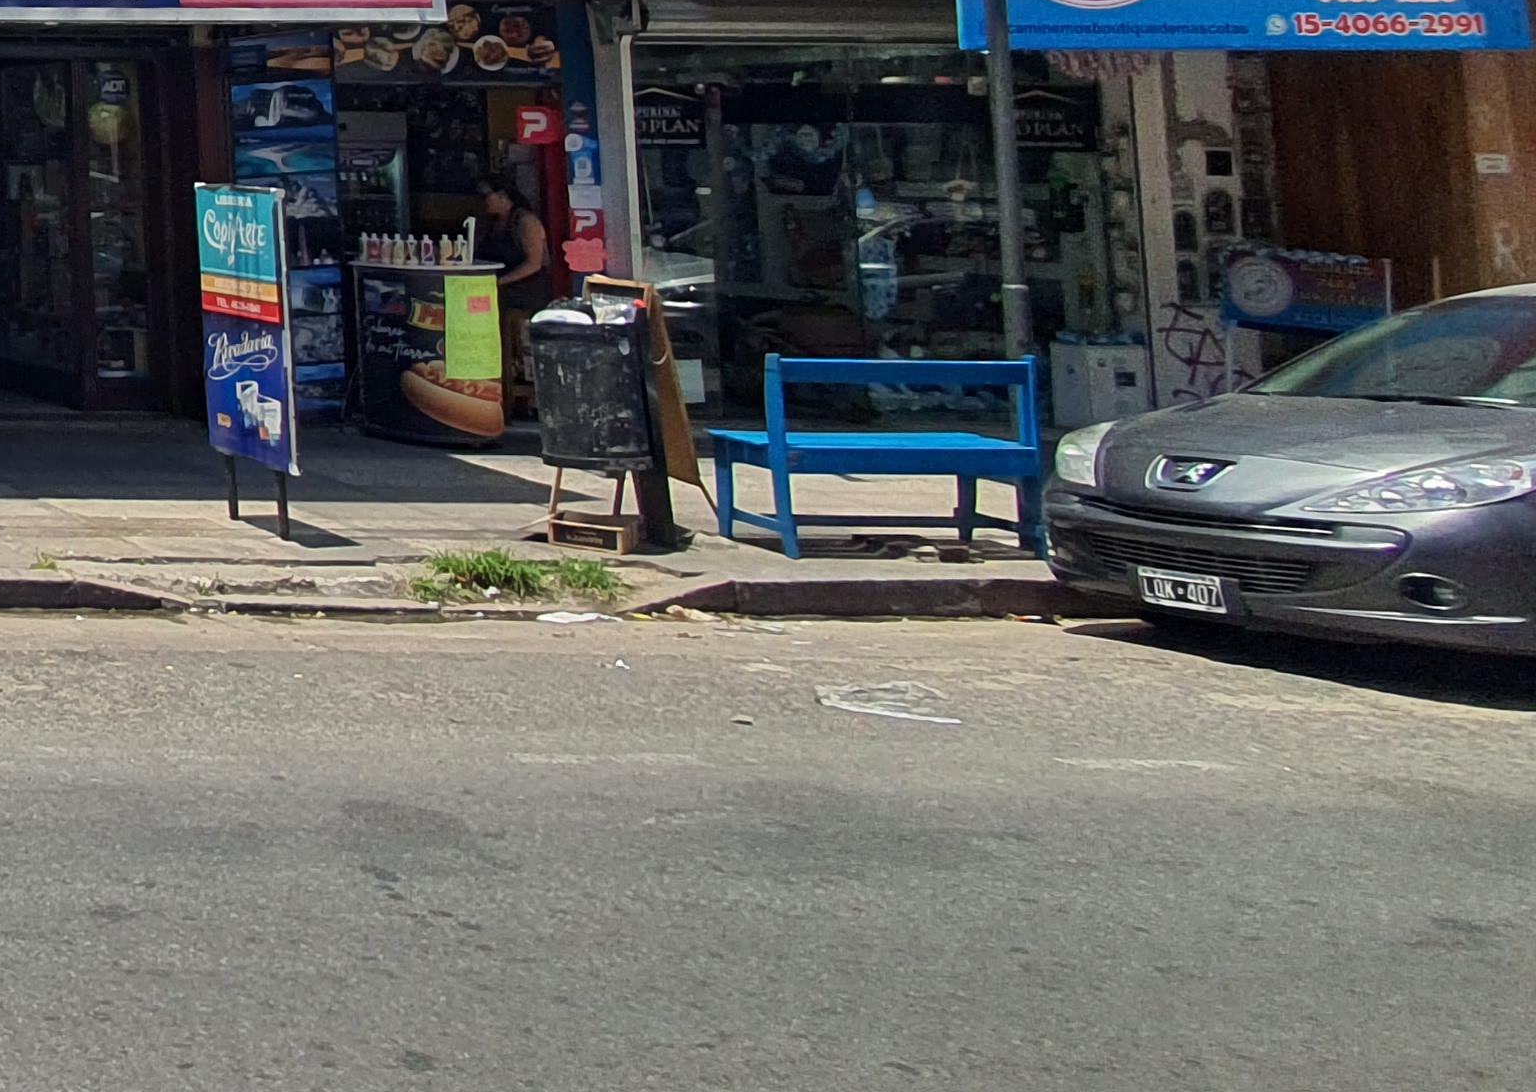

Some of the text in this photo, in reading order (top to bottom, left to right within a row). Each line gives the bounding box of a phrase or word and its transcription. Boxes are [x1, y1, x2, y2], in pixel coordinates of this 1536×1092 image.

[1292, 12, 1487, 37] 15-4066-2991
[101, 79, 126, 93] ADT
[650, 119, 700, 133] PLAN
[208, 330, 278, 380] Rivadavia
